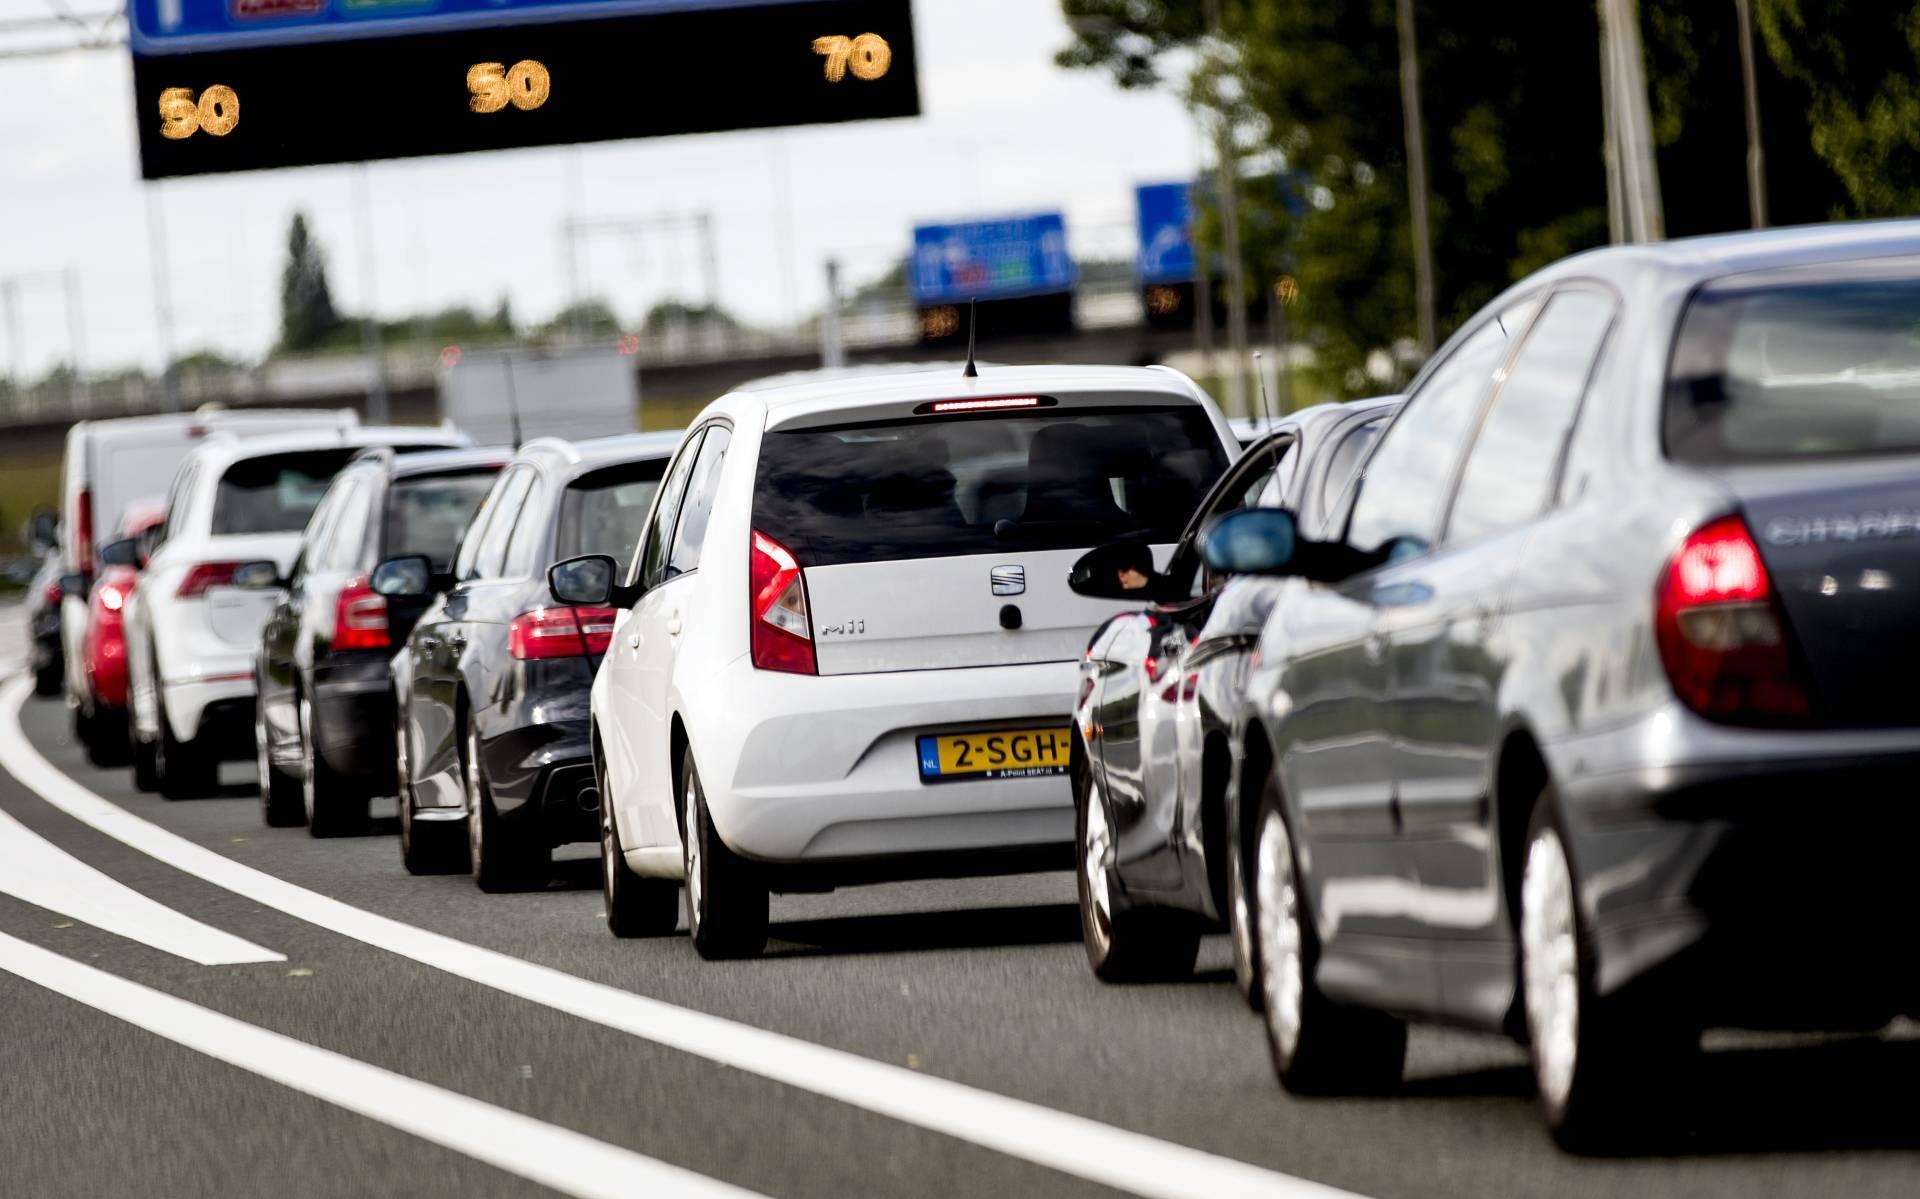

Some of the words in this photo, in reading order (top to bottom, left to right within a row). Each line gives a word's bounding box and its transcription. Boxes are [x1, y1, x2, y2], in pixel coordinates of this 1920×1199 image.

[812, 32, 891, 81] 70
[159, 84, 240, 139] 50
[467, 60, 550, 113] 50
[923, 759, 938, 769] NL
